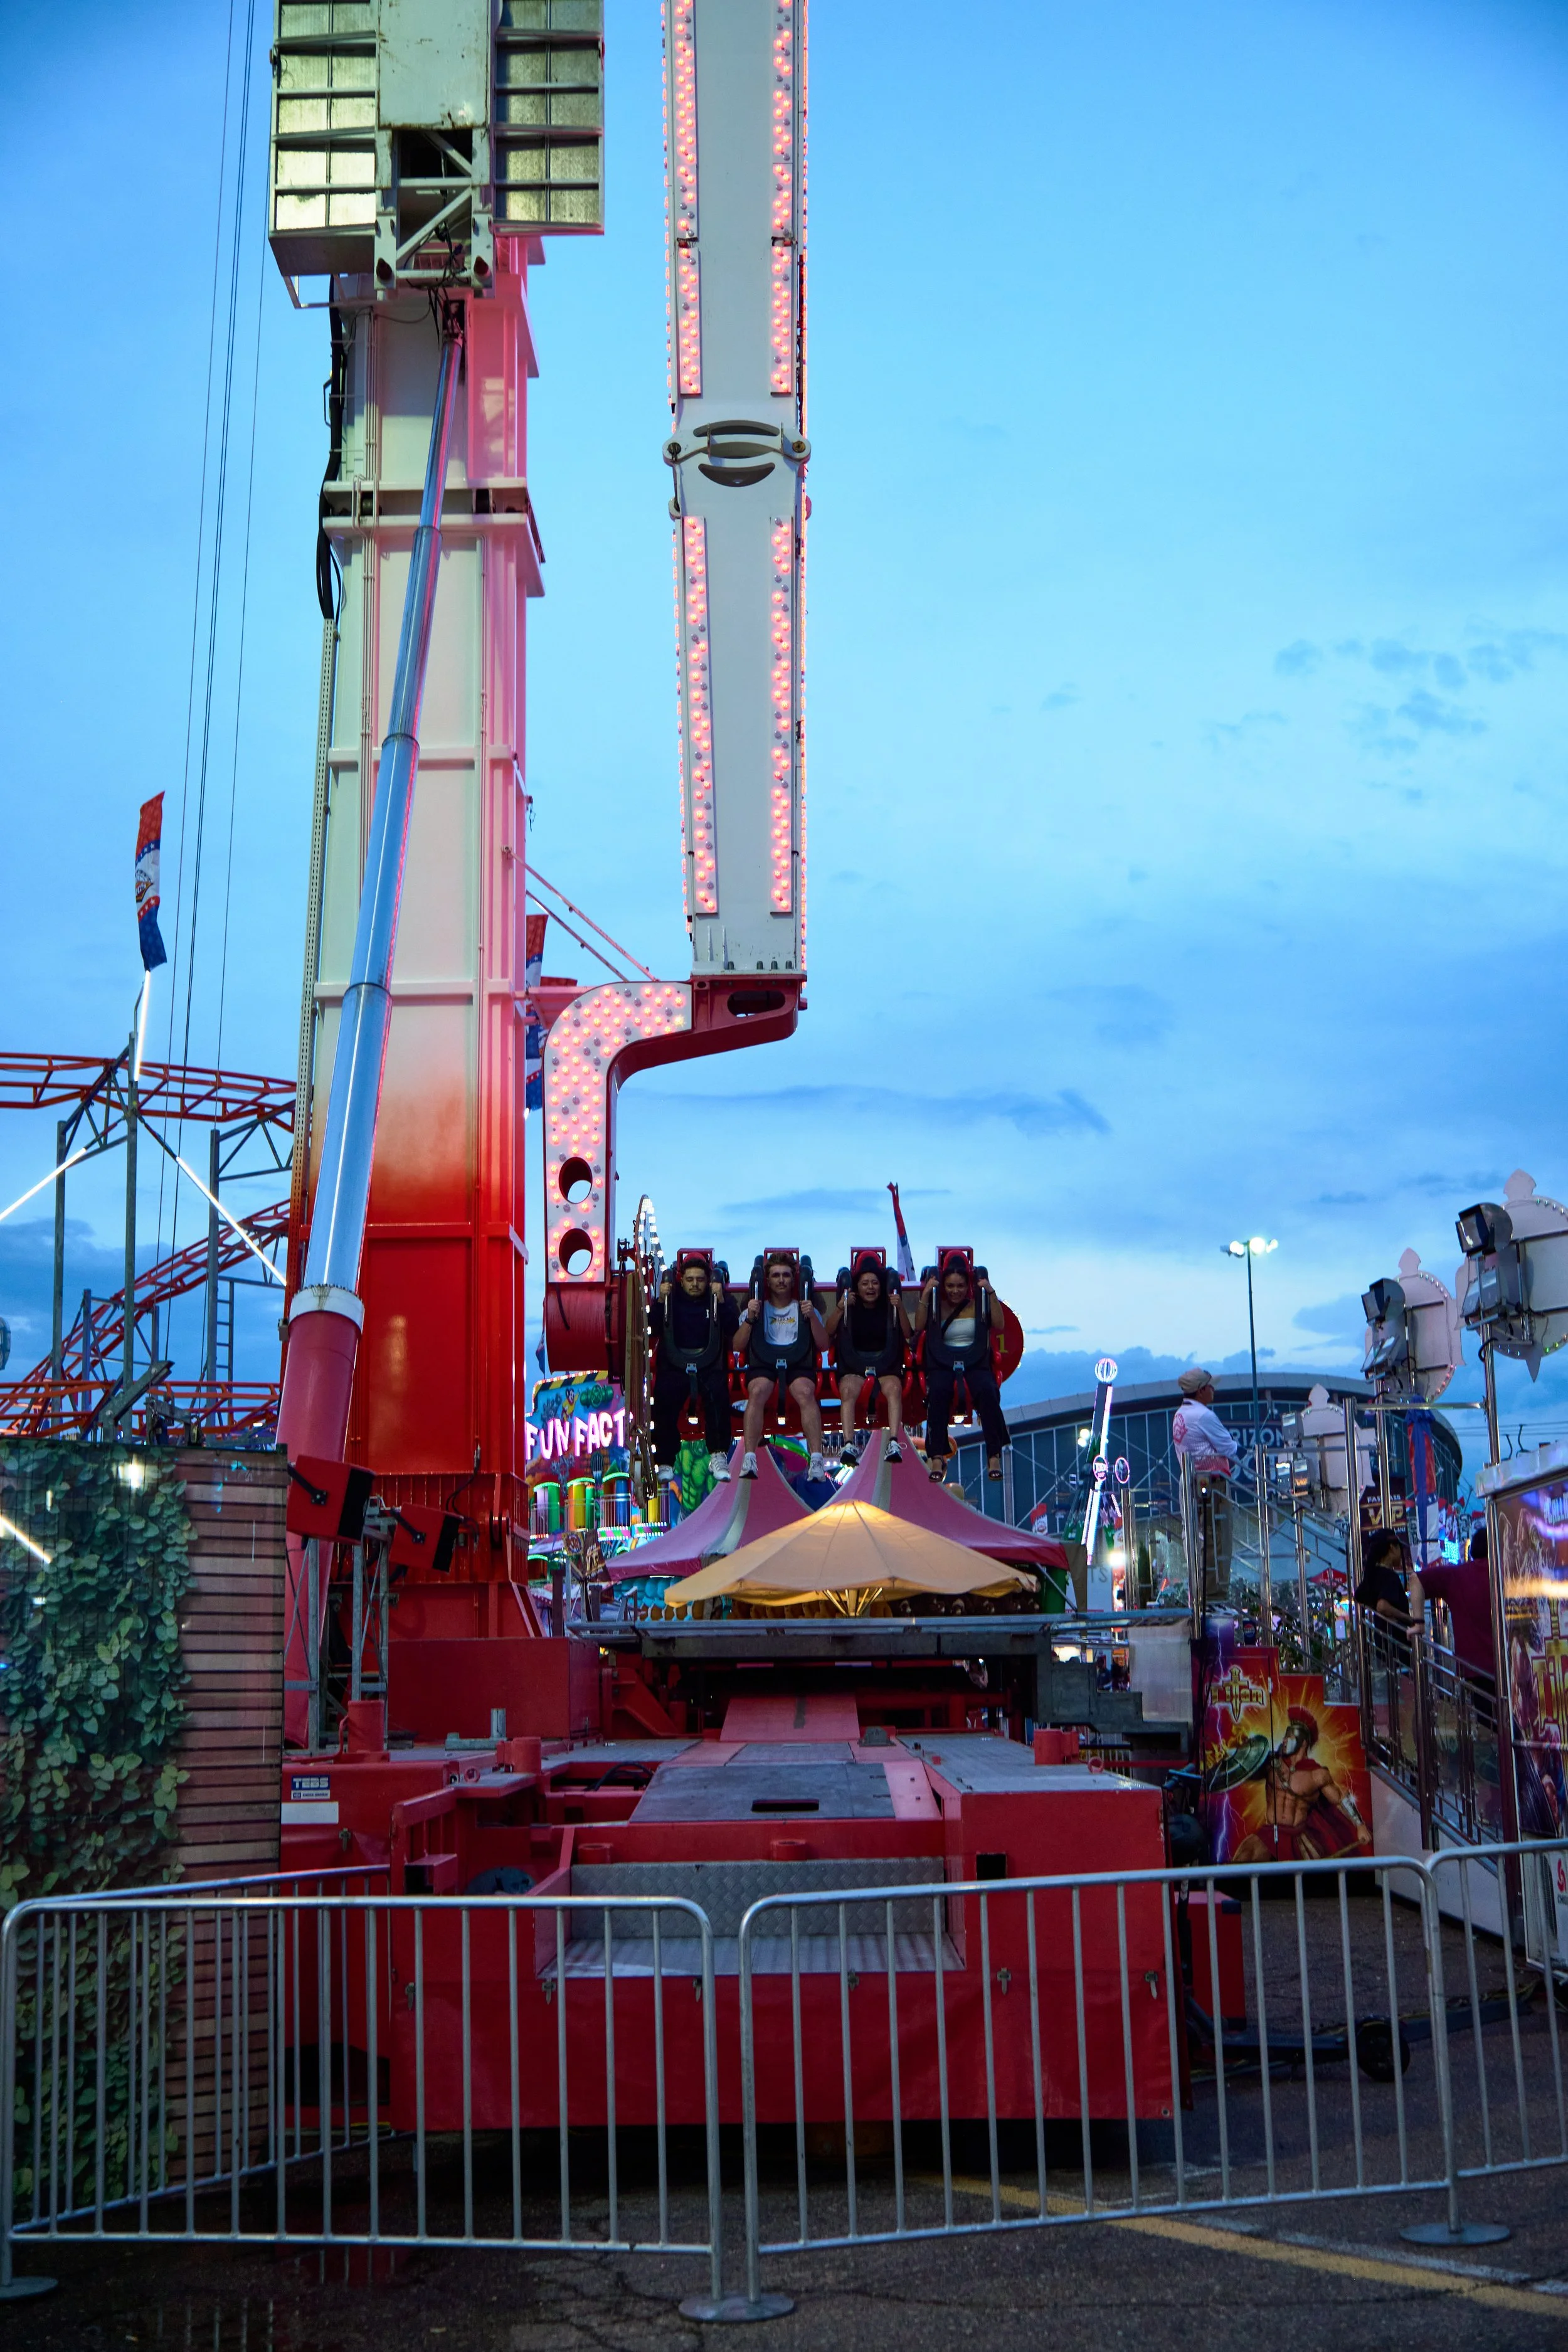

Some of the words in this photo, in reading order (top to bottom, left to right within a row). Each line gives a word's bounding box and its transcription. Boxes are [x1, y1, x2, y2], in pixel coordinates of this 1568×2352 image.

[996, 1334, 1009, 1353] 1
[525, 1418, 569, 1460] FUN
[574, 1407, 630, 1457] FACT
